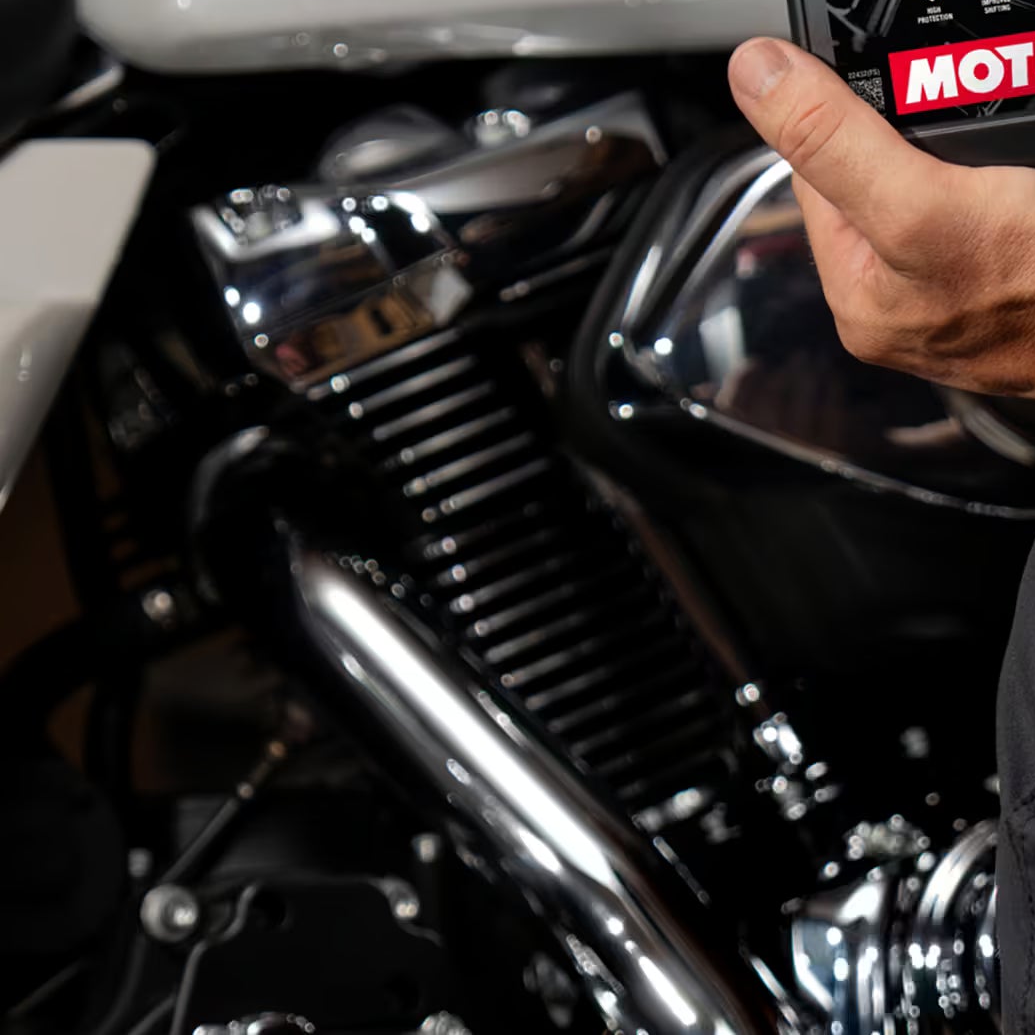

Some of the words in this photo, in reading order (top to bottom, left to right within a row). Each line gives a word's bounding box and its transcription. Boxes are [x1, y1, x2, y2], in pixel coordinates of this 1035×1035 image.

[926, 6, 942, 15] HIGH
[984, 4, 1012, 15] SHIFTING
[917, 13, 954, 25] PROTECTION
